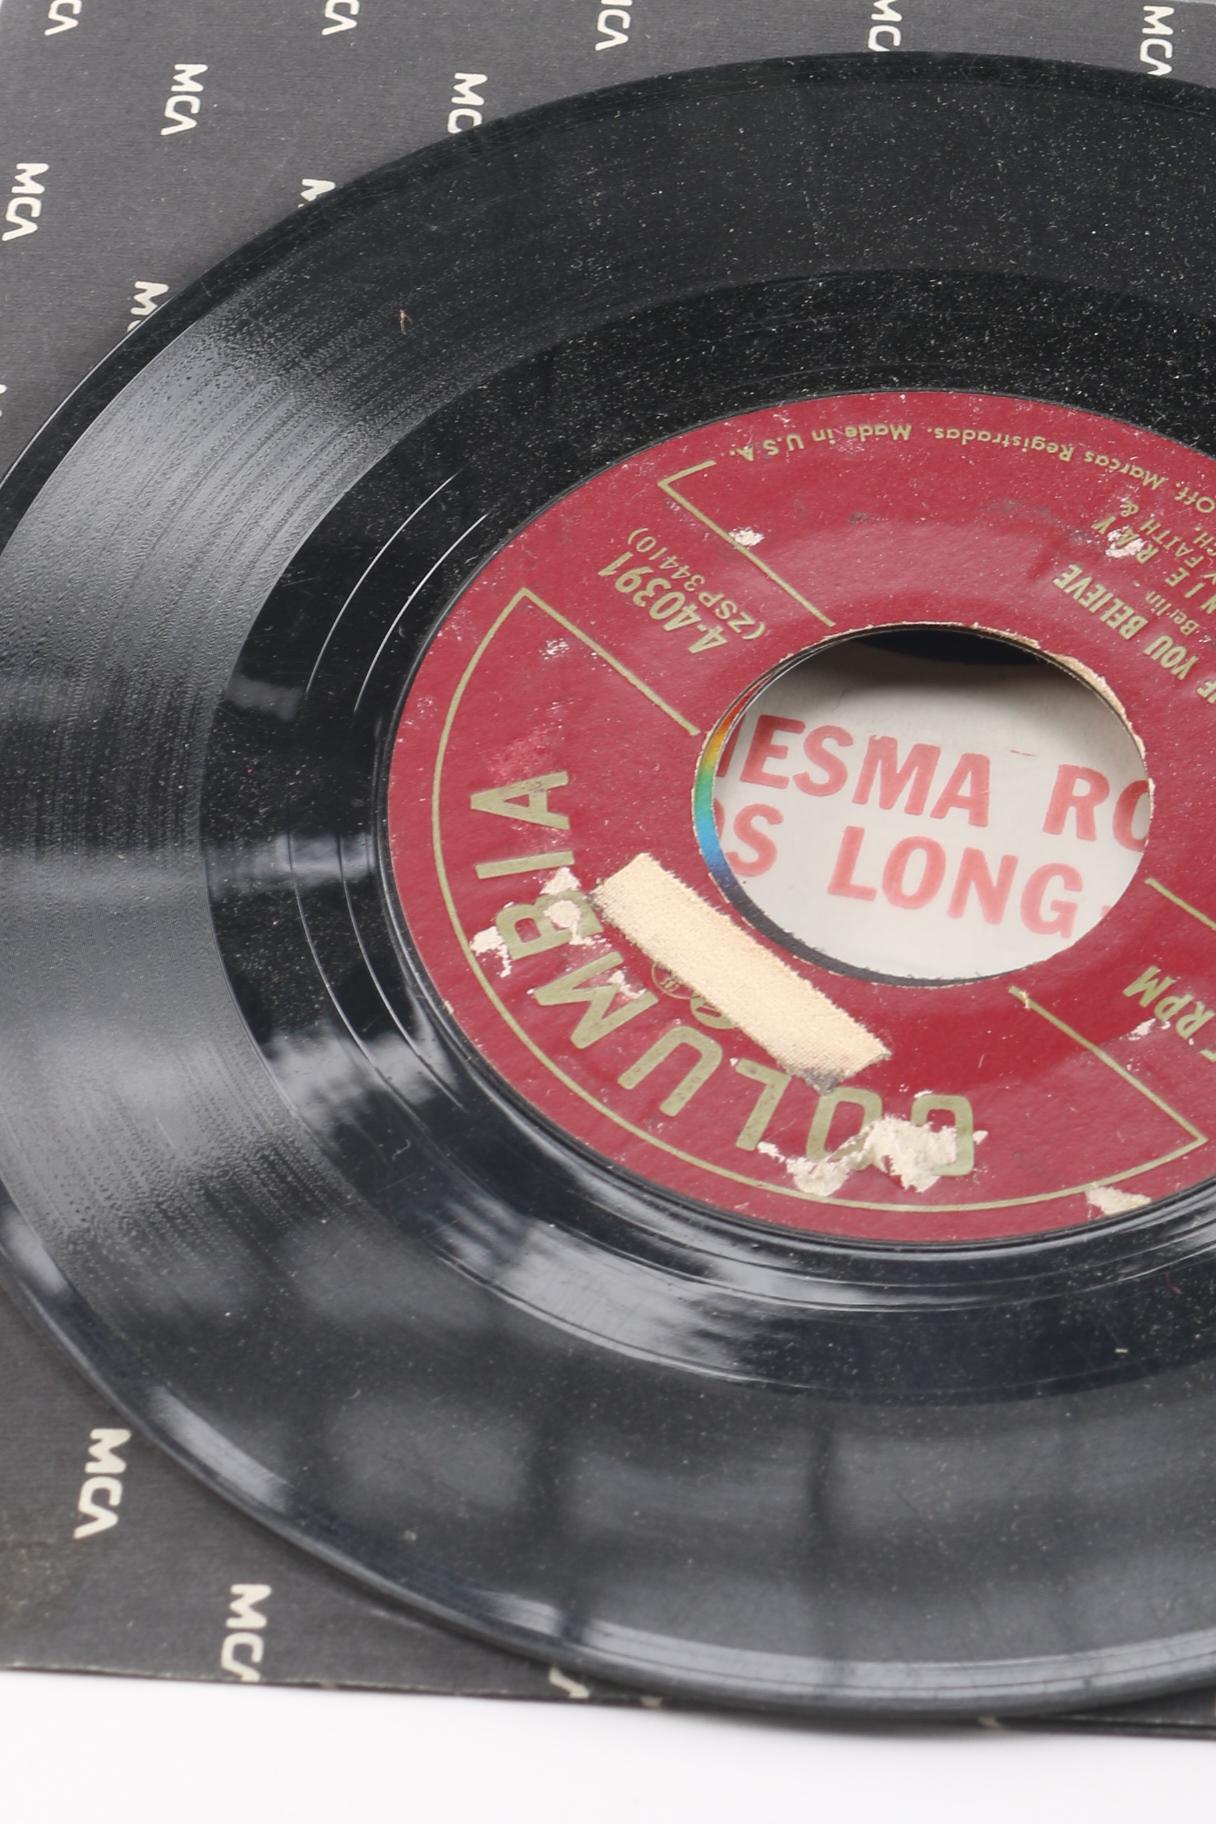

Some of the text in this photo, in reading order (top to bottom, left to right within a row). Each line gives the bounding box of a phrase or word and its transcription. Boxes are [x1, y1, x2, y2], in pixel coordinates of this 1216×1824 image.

[161, 64, 208, 135] MCA
[448, 72, 488, 134] MC
[2, 163, 49, 241] MCA
[812, 428, 836, 443] in
[845, 423, 912, 440] Made
[927, 426, 1073, 462] Registradas.
[1084, 449, 1167, 490] Marcas
[1119, 497, 1140, 517] &
[1174, 482, 1216, 513] Off.
[1091, 516, 1159, 565] RAY
[1139, 519, 1205, 569] FAITH
[597, 551, 728, 654] 4-40391
[1052, 563, 1148, 640] BELIEVE
[1145, 590, 1200, 636] Berlin
[1143, 635, 1199, 680] YOU
[712, 797, 784, 877] S
[470, 771, 976, 1177] COLUMBIA
[1122, 965, 1216, 1040] RPM
[74, 1429, 131, 1538] MCA
